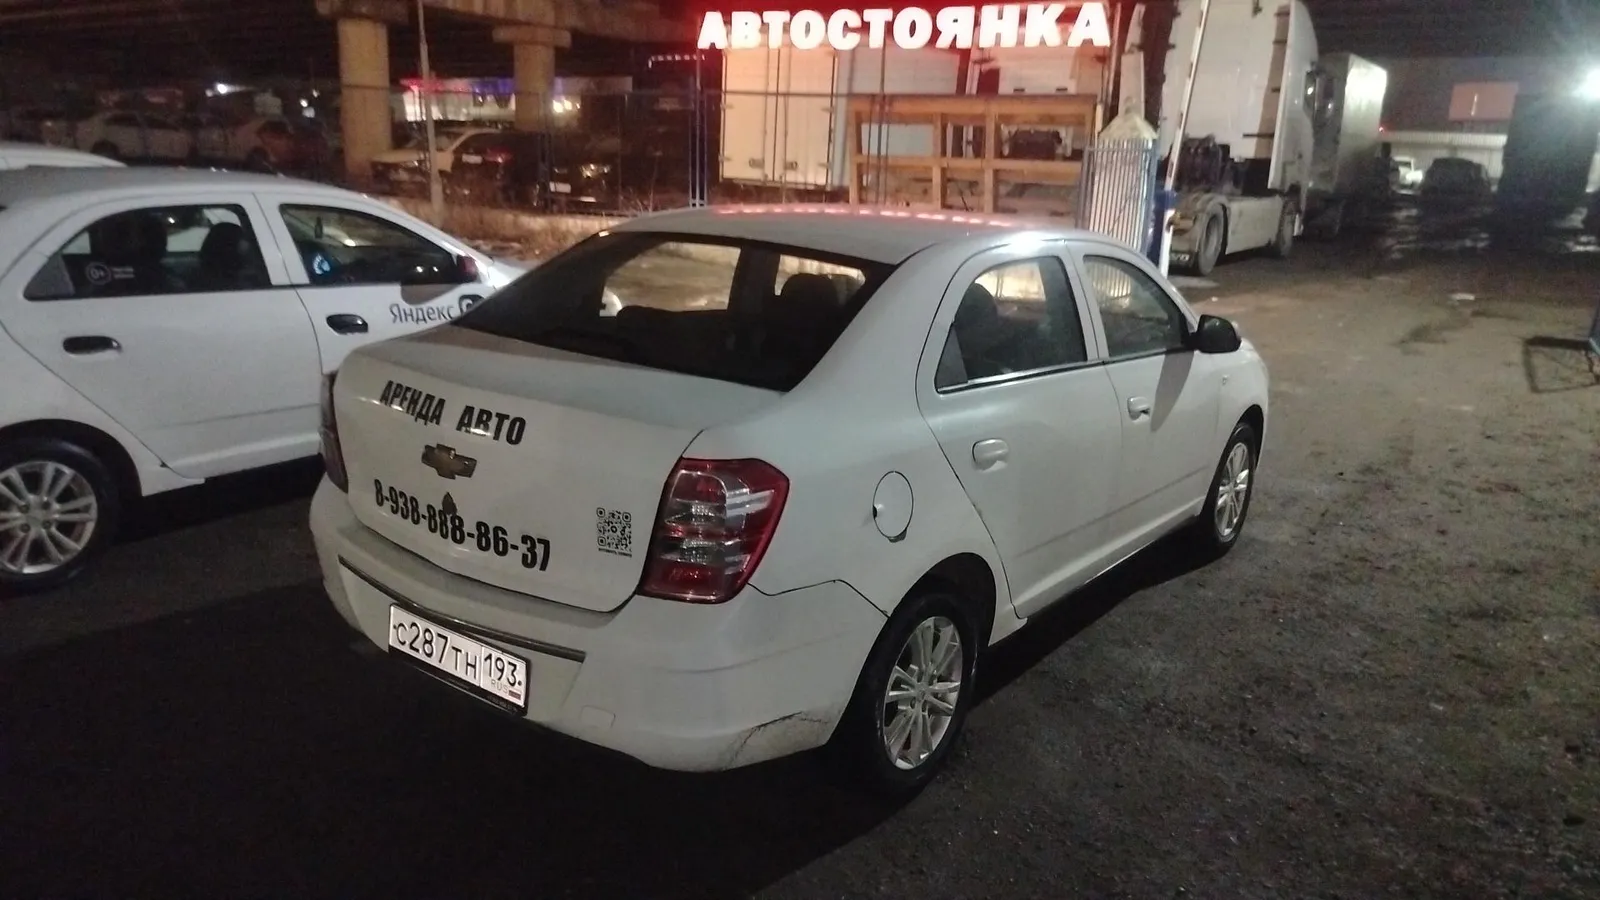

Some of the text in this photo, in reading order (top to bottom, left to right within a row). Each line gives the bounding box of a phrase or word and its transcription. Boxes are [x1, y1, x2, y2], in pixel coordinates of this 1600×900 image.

[697, 2, 1111, 50] АВТОСТОЯНКА
[389, 303, 454, 324] Яндекс
[379, 380, 527, 446] АРЕНДА АВТО
[373, 479, 551, 572] 8-938-888-86-37
